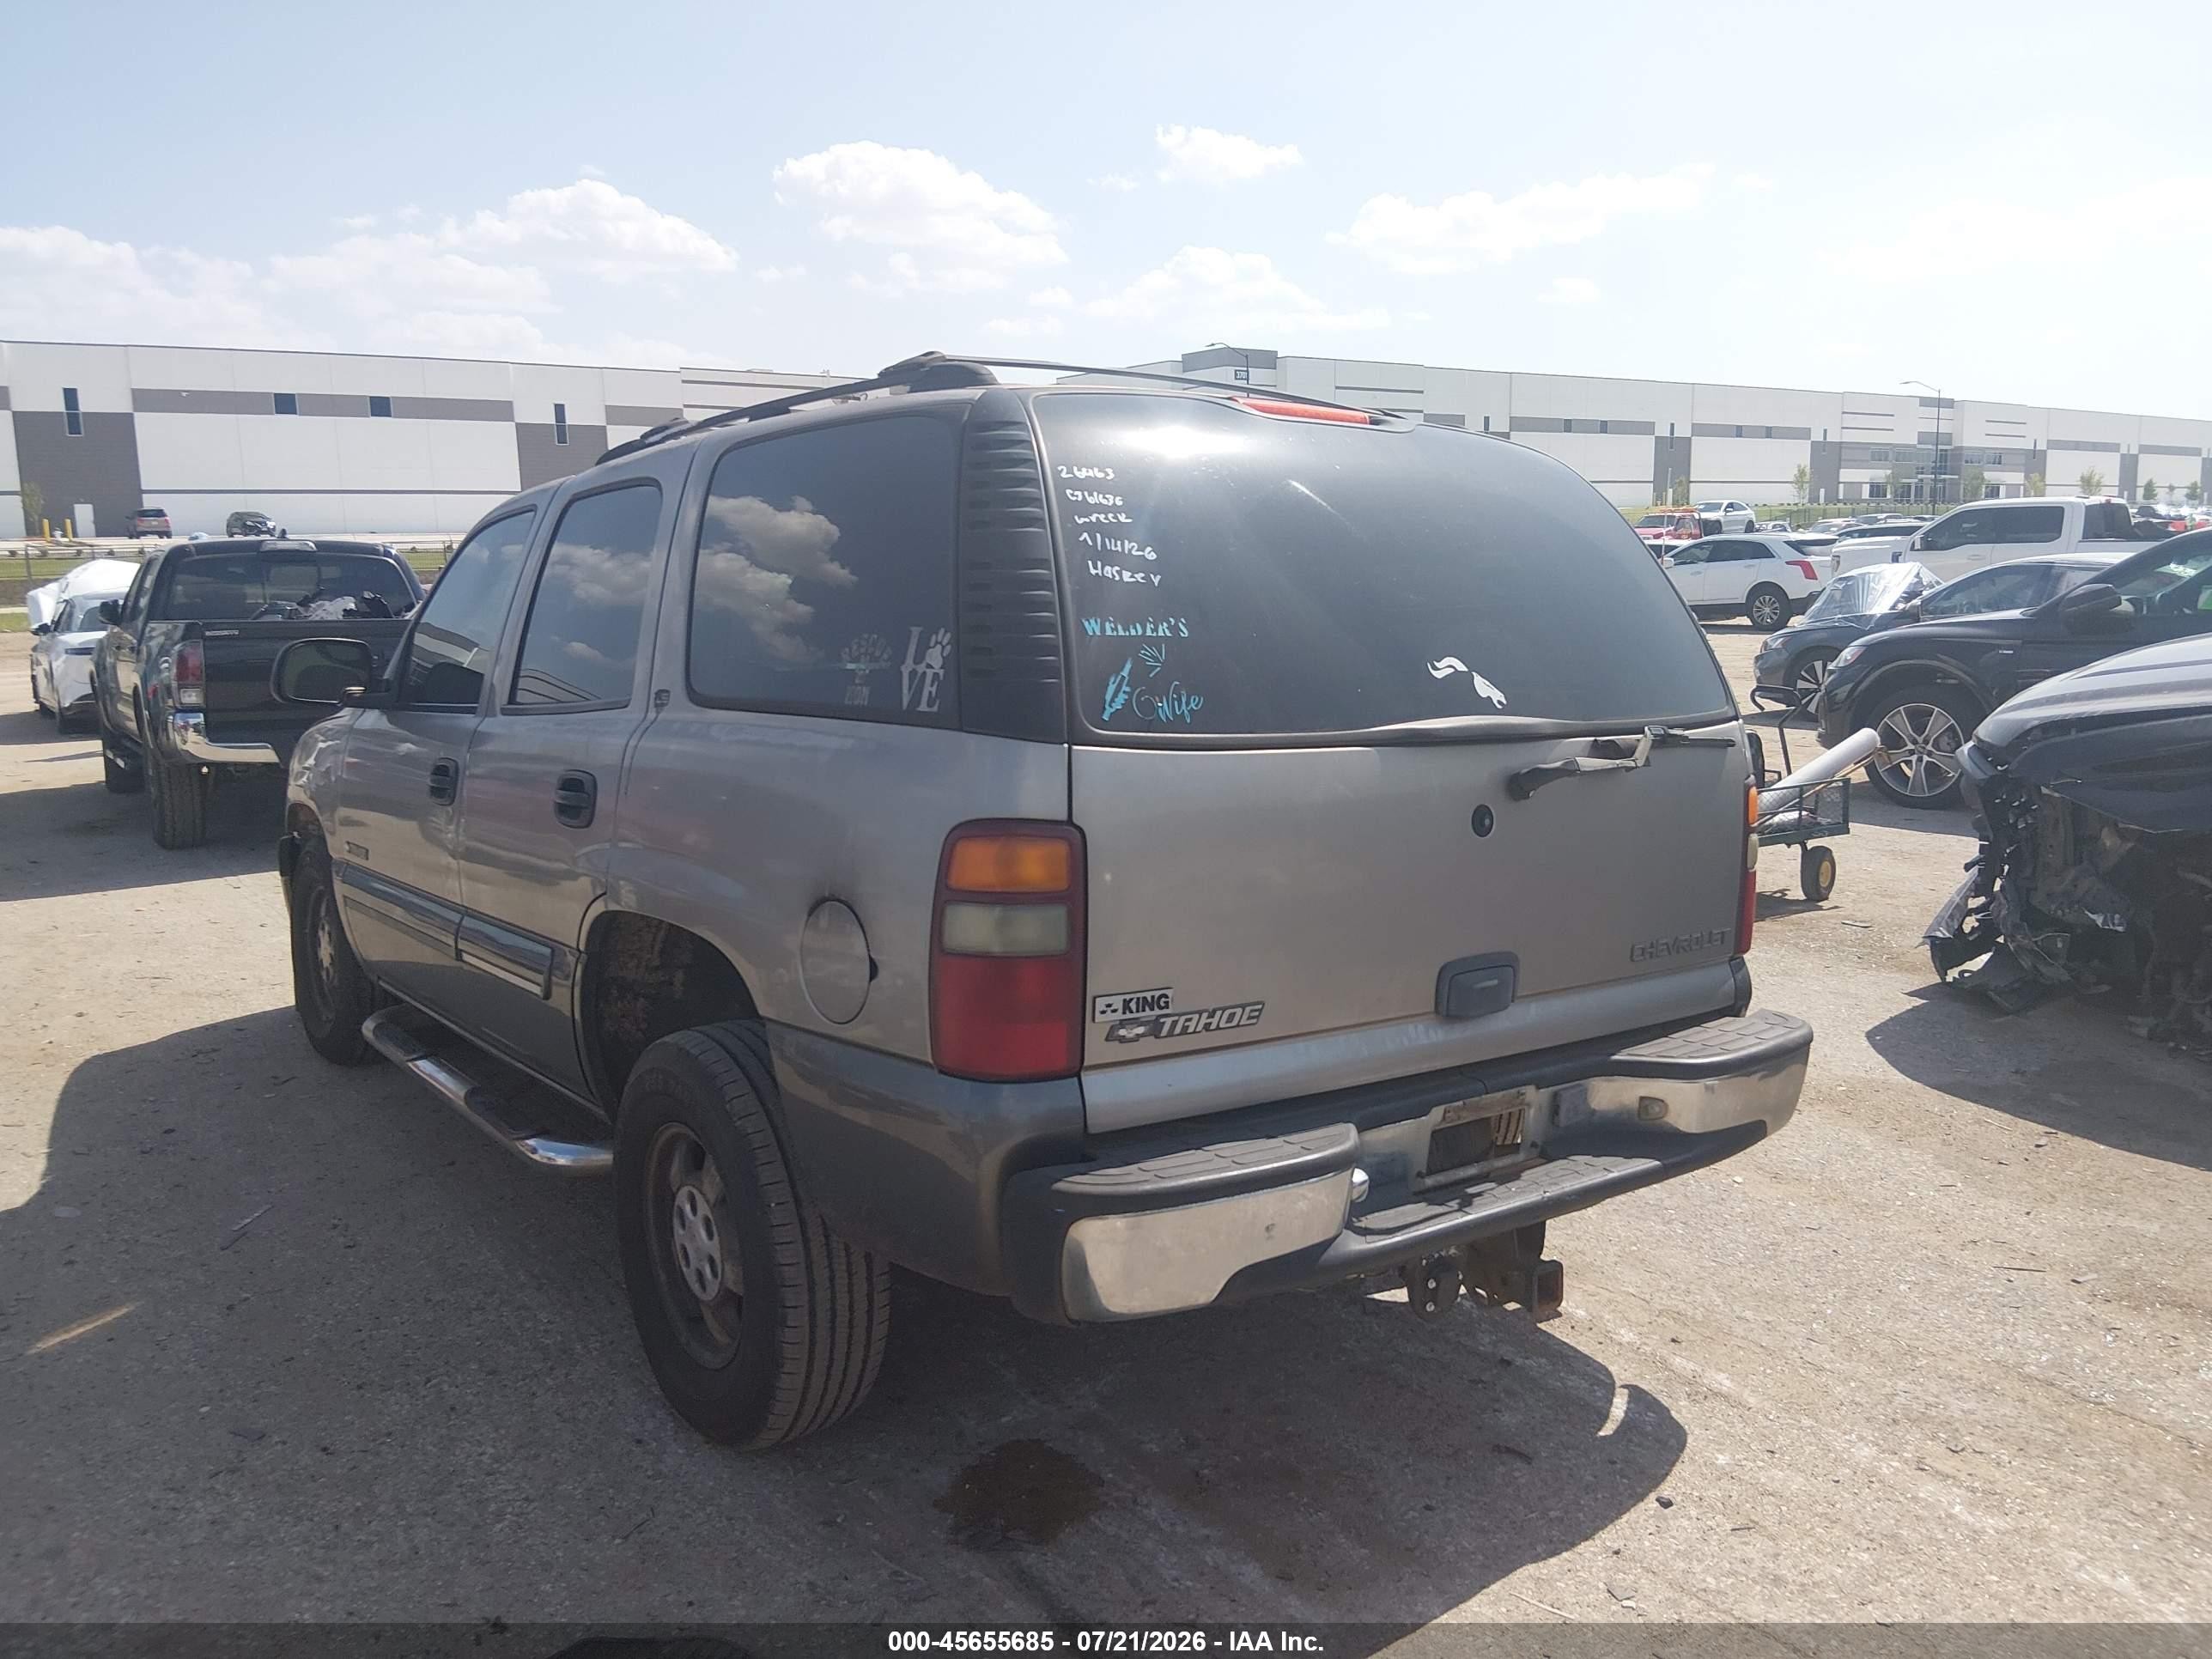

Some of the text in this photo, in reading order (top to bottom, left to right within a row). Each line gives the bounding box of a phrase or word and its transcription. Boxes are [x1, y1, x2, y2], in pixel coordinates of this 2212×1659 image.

[1133, 681, 1203, 723] Wife
[1629, 927, 1731, 962] CHEVROLET
[1121, 993, 1170, 1014] KING
[1159, 1004, 1263, 1036] TAHOE
